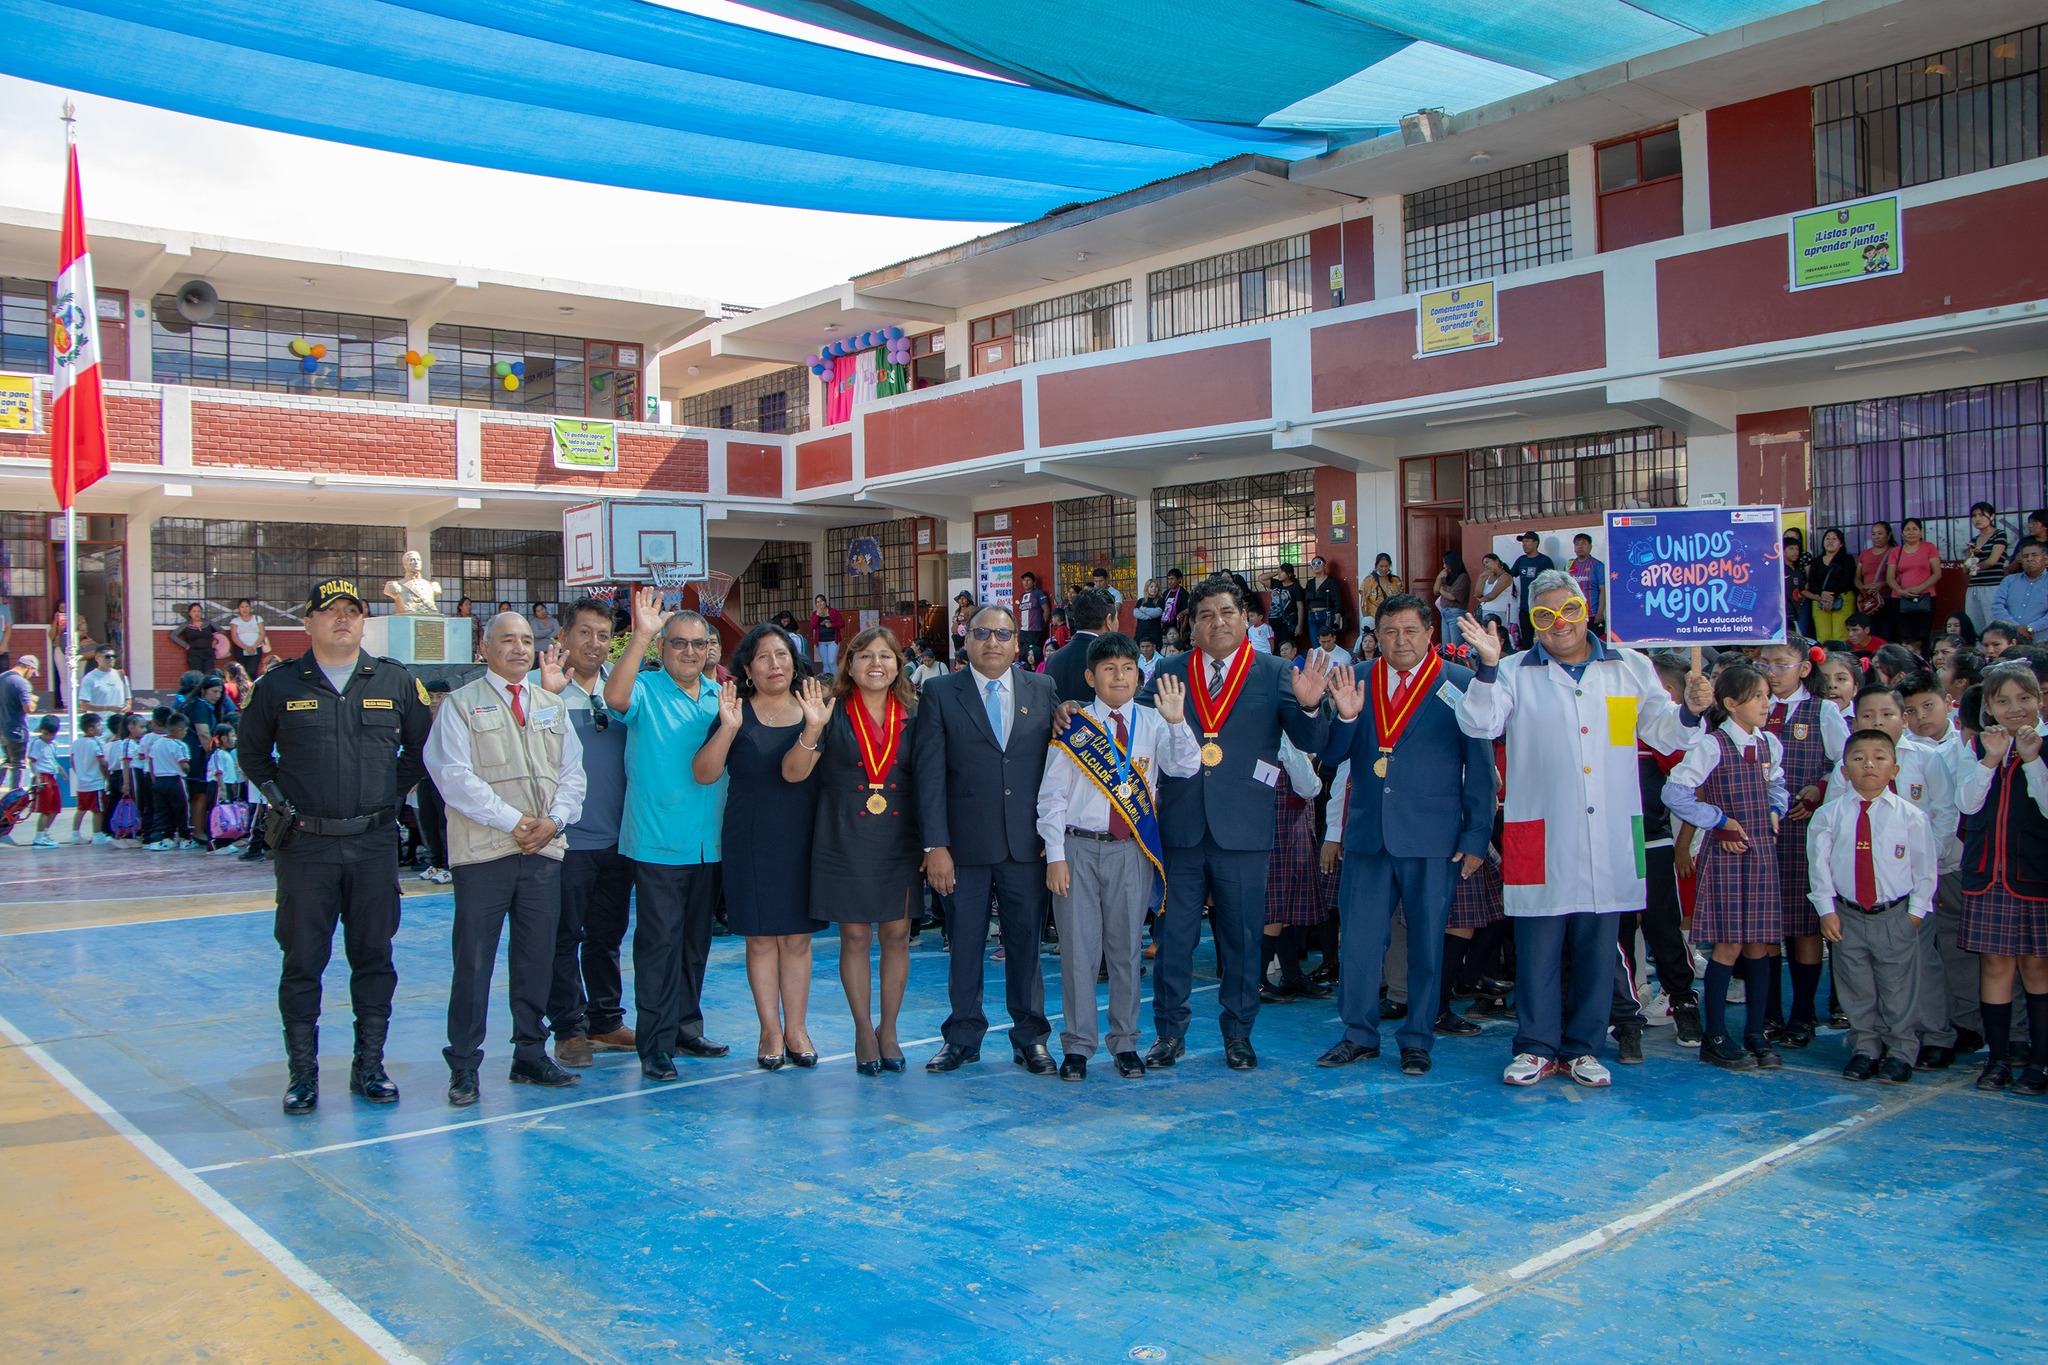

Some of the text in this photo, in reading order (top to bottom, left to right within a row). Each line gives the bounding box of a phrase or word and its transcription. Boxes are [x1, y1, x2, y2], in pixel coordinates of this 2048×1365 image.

[1815, 223, 1875, 242] ¡Listos para
[1804, 232, 1889, 257] aprender juntos!
[1436, 313, 1467, 324] aventura
[1702, 498, 1722, 506] SALIDA
[319, 580, 359, 599] POLICIA
[1710, 616, 1753, 624] educación
[1693, 625, 1712, 633] lleva
[1714, 625, 1731, 633] más
[1733, 625, 1753, 633] lejos
[1079, 749, 1114, 784] ALCALDE
